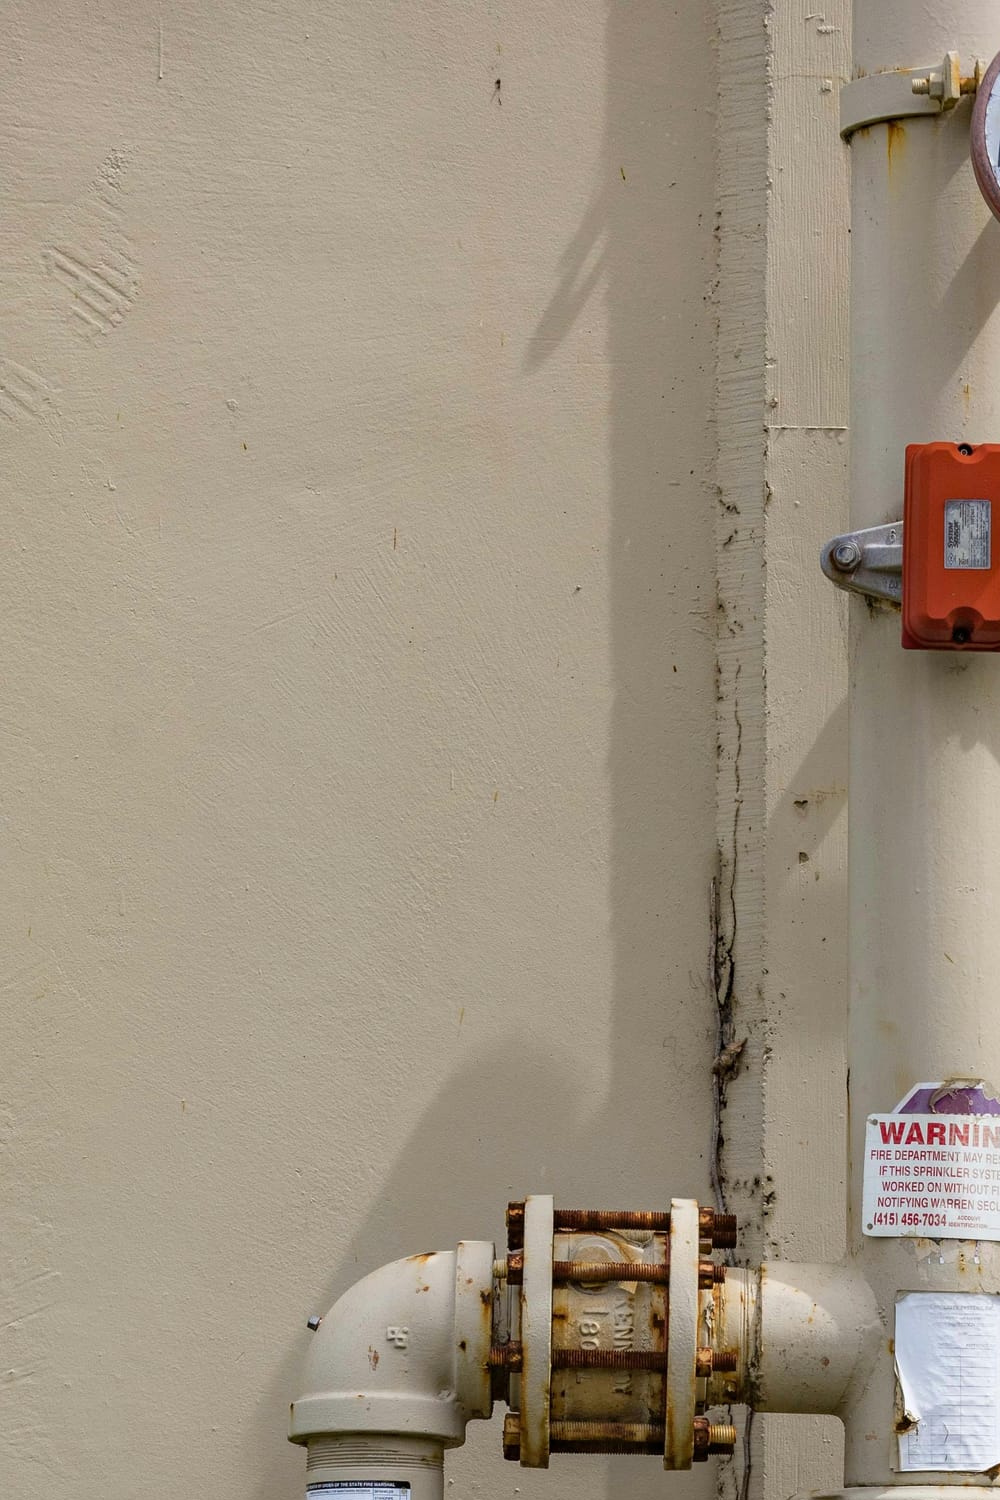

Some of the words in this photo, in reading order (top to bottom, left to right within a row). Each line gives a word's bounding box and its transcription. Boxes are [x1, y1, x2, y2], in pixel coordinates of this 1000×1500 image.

[870, 1150, 892, 1161] FIRE
[894, 1150, 961, 1163] DEPARTMENT
[963, 1152, 984, 1163] MAY
[879, 1165, 889, 1176] IF
[890, 1165, 911, 1177] THIS
[913, 1166, 970, 1179] SPRINKLER
[882, 1181, 925, 1193] WORKED
[927, 1182, 942, 1193] ON
[944, 1183, 989, 1195] WITHOUT
[877, 1197, 928, 1209] NOTIFYING
[930, 1198, 975, 1210] WARREN
[901, 1213, 947, 1227] 456-7034
